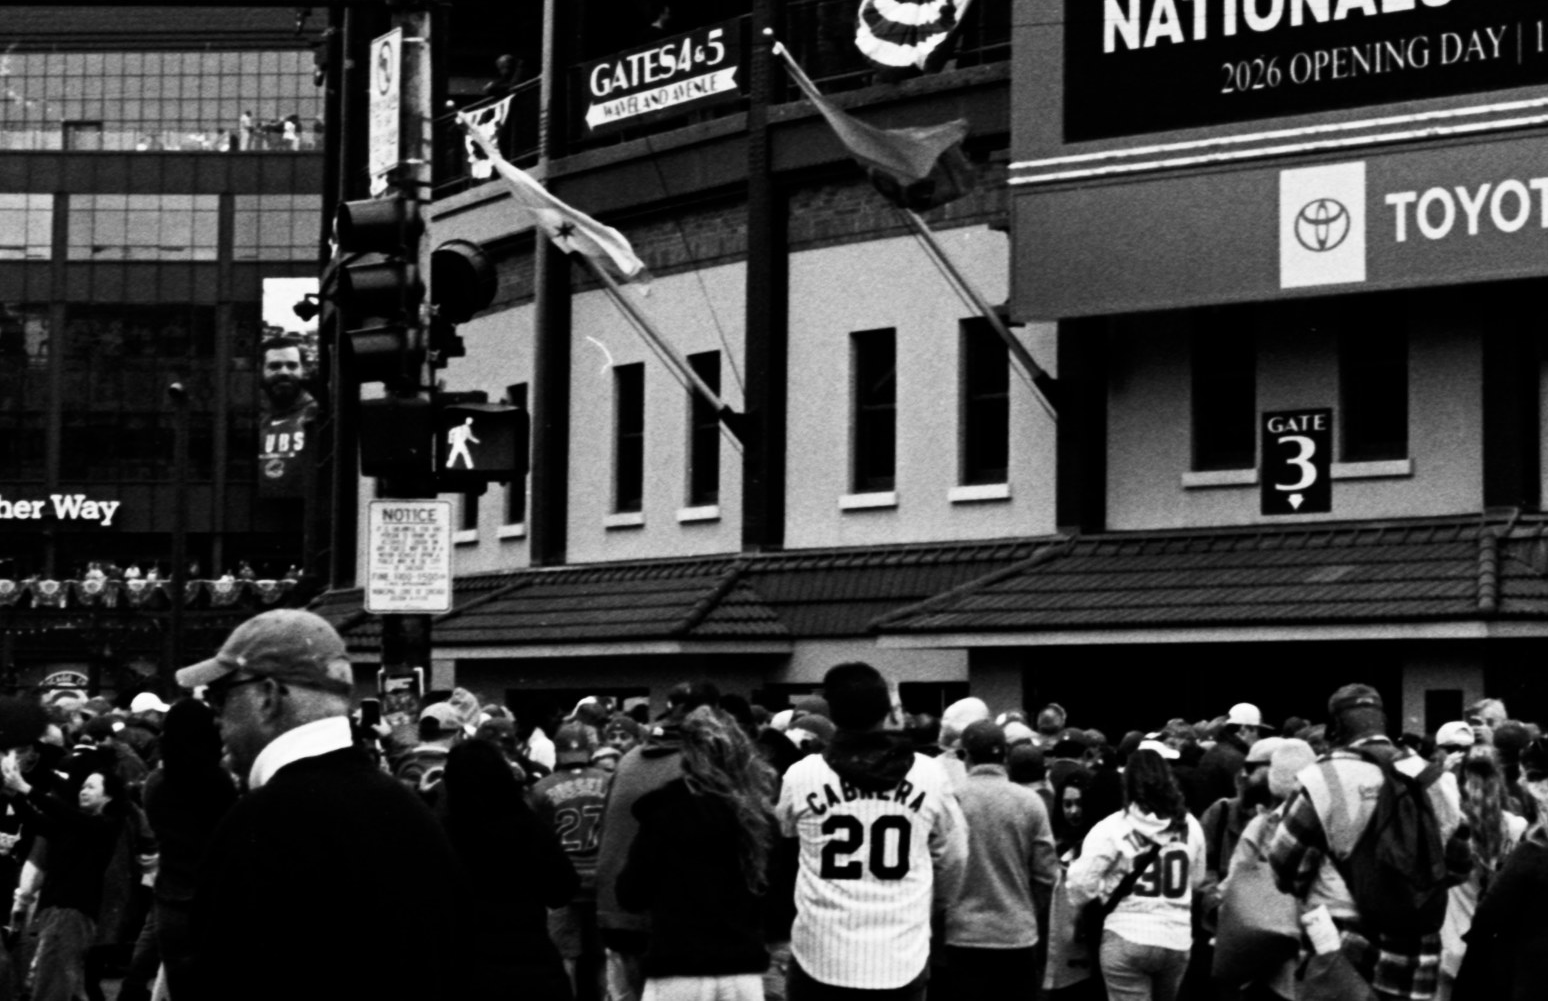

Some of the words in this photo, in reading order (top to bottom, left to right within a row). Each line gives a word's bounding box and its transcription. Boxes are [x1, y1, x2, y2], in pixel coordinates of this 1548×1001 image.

[590, 43, 677, 97] GATES
[1220, 52, 1282, 94] 2026
[1289, 35, 1430, 85] OPENING
[1440, 25, 1508, 65] DAY
[1267, 414, 1327, 434] GATE
[1275, 435, 1317, 491] 3
[50, 494, 121, 527] Way
[382, 508, 437, 522] NOTICE
[806, 780, 926, 815] CABRA
[555, 804, 604, 852] 27
[820, 814, 912, 880] 20
